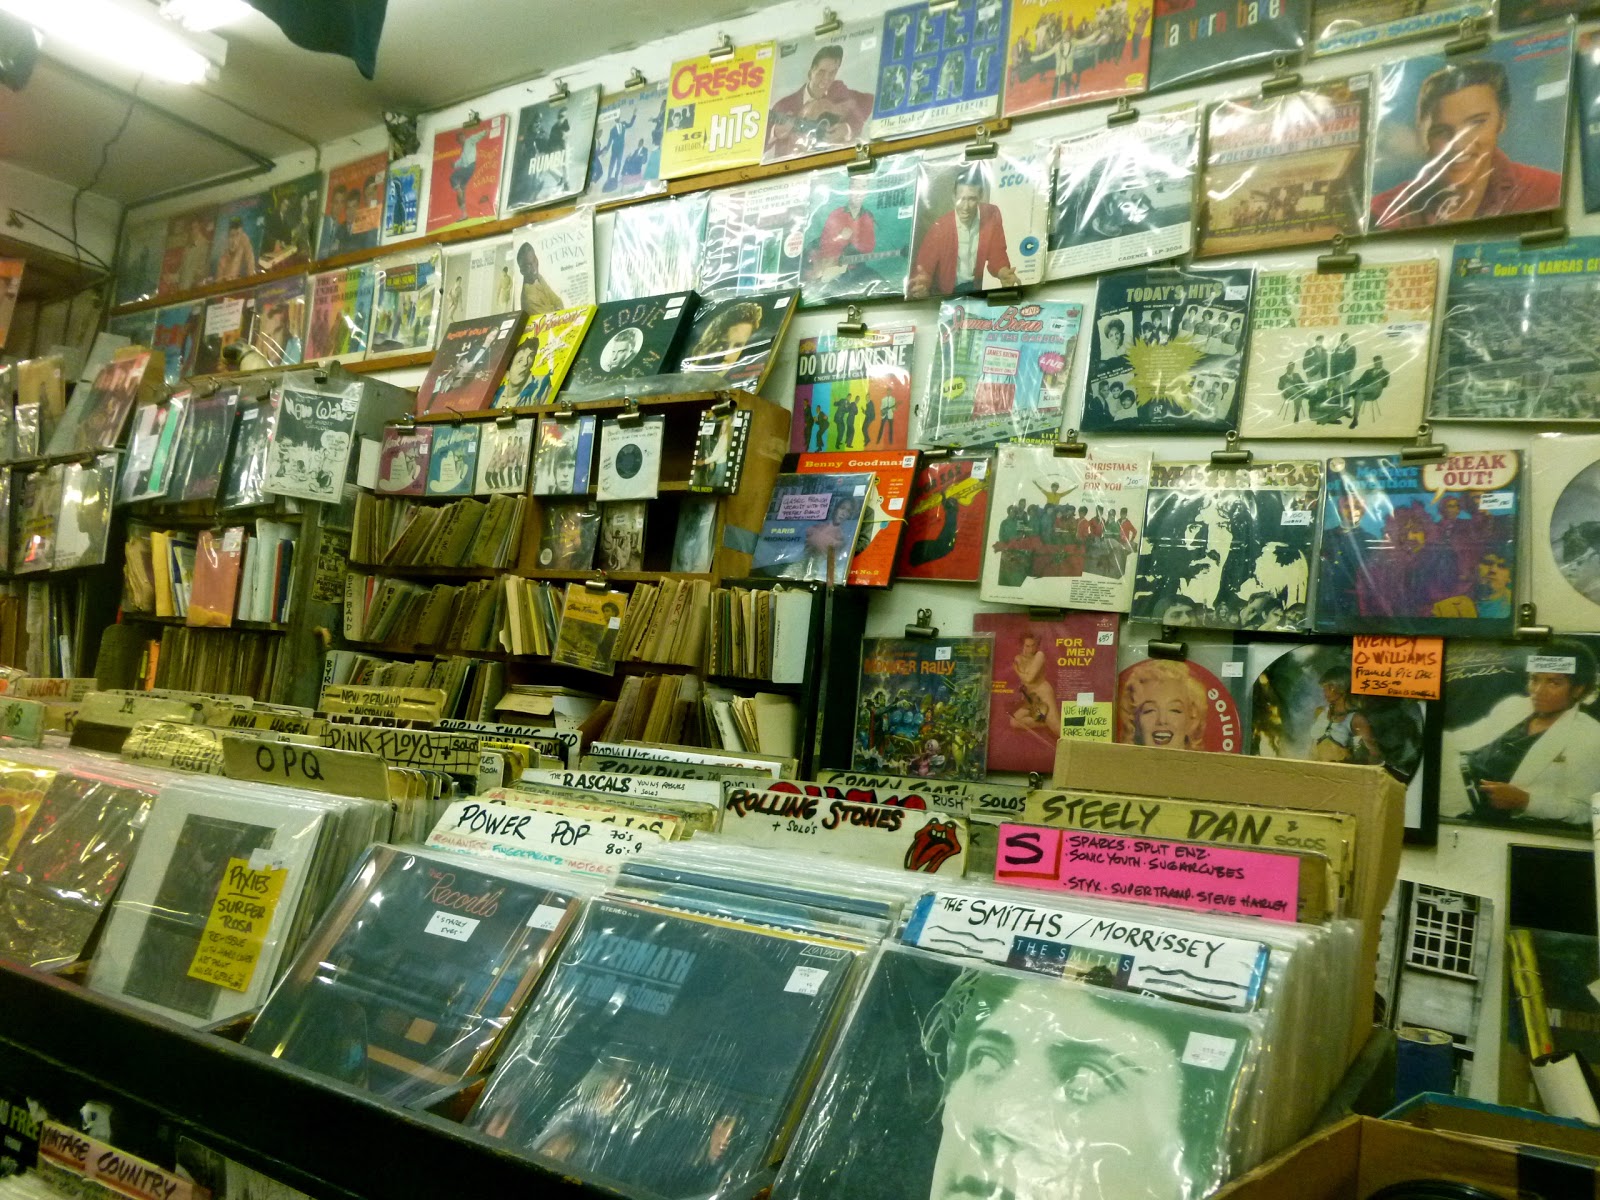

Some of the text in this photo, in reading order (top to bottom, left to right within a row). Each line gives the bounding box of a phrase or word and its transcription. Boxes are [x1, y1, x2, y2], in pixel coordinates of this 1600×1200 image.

[1189, 11, 1227, 41] vern
[671, 61, 765, 100] CRESTS
[879, 44, 999, 112] BEAT
[682, 132, 702, 141] 16
[709, 104, 760, 152] HITS
[1538, 259, 1583, 274] KANSAS
[1126, 283, 1223, 302] TODAY'S HITS
[603, 302, 665, 334] EDDIE
[1001, 333, 1018, 342] THE
[800, 355, 816, 375] DO
[1039, 358, 1064, 369] LIVE
[737, 413, 750, 463] MACHINE
[805, 460, 843, 469] Benny
[1086, 462, 1138, 471] CHRISTMAS
[1435, 454, 1507, 472] FREAK
[731, 465, 740, 493] CITY
[1083, 482, 1122, 491] FOR YOU
[1443, 471, 1493, 486] OUT!
[345, 602, 353, 631] BAND
[1056, 638, 1083, 647] FOR
[1356, 636, 1418, 650] WENDY
[1066, 648, 1095, 657] MEN
[1372, 650, 1437, 666] WILLIAMS
[1057, 658, 1093, 667] ONLY
[342, 690, 401, 707] NEW ZEALAND
[1063, 706, 1098, 715] WE HAVE
[1208, 688, 1234, 751] onroe
[229, 715, 257, 728] NINA
[1086, 717, 1108, 726] MORE
[329, 728, 372, 750] PINK
[1062, 728, 1082, 737] RARE
[256, 745, 275, 772] O
[283, 746, 297, 777] P
[302, 751, 324, 781] Q
[562, 772, 632, 793] RASCALS
[726, 789, 818, 819] ROLLING
[822, 802, 905, 832] STONES
[931, 795, 965, 809] RUSH
[979, 794, 1027, 811] SOLOS
[458, 804, 531, 840] POWER
[552, 820, 590, 846] POP
[1042, 795, 1326, 850] STEELY DAN SOLOS
[1005, 833, 1043, 865] S
[1133, 841, 1170, 856] SPLIT
[568, 860, 614, 874] MOTORS
[1069, 851, 1245, 880] SONIC YOUTH SUGARCUBES
[229, 865, 271, 893] PIXIES
[218, 899, 265, 919] SURFER
[600, 906, 628, 916] STEREO
[1198, 891, 1236, 907] STEVE
[1241, 897, 1288, 913] HARLEY
[220, 915, 252, 933] ROSA
[941, 896, 1226, 968] THE SMITHS MORRISSEY
[1016, 939, 1133, 973] THE SMITHS
[43, 1126, 178, 1200] VINTAGE COUNTRY
